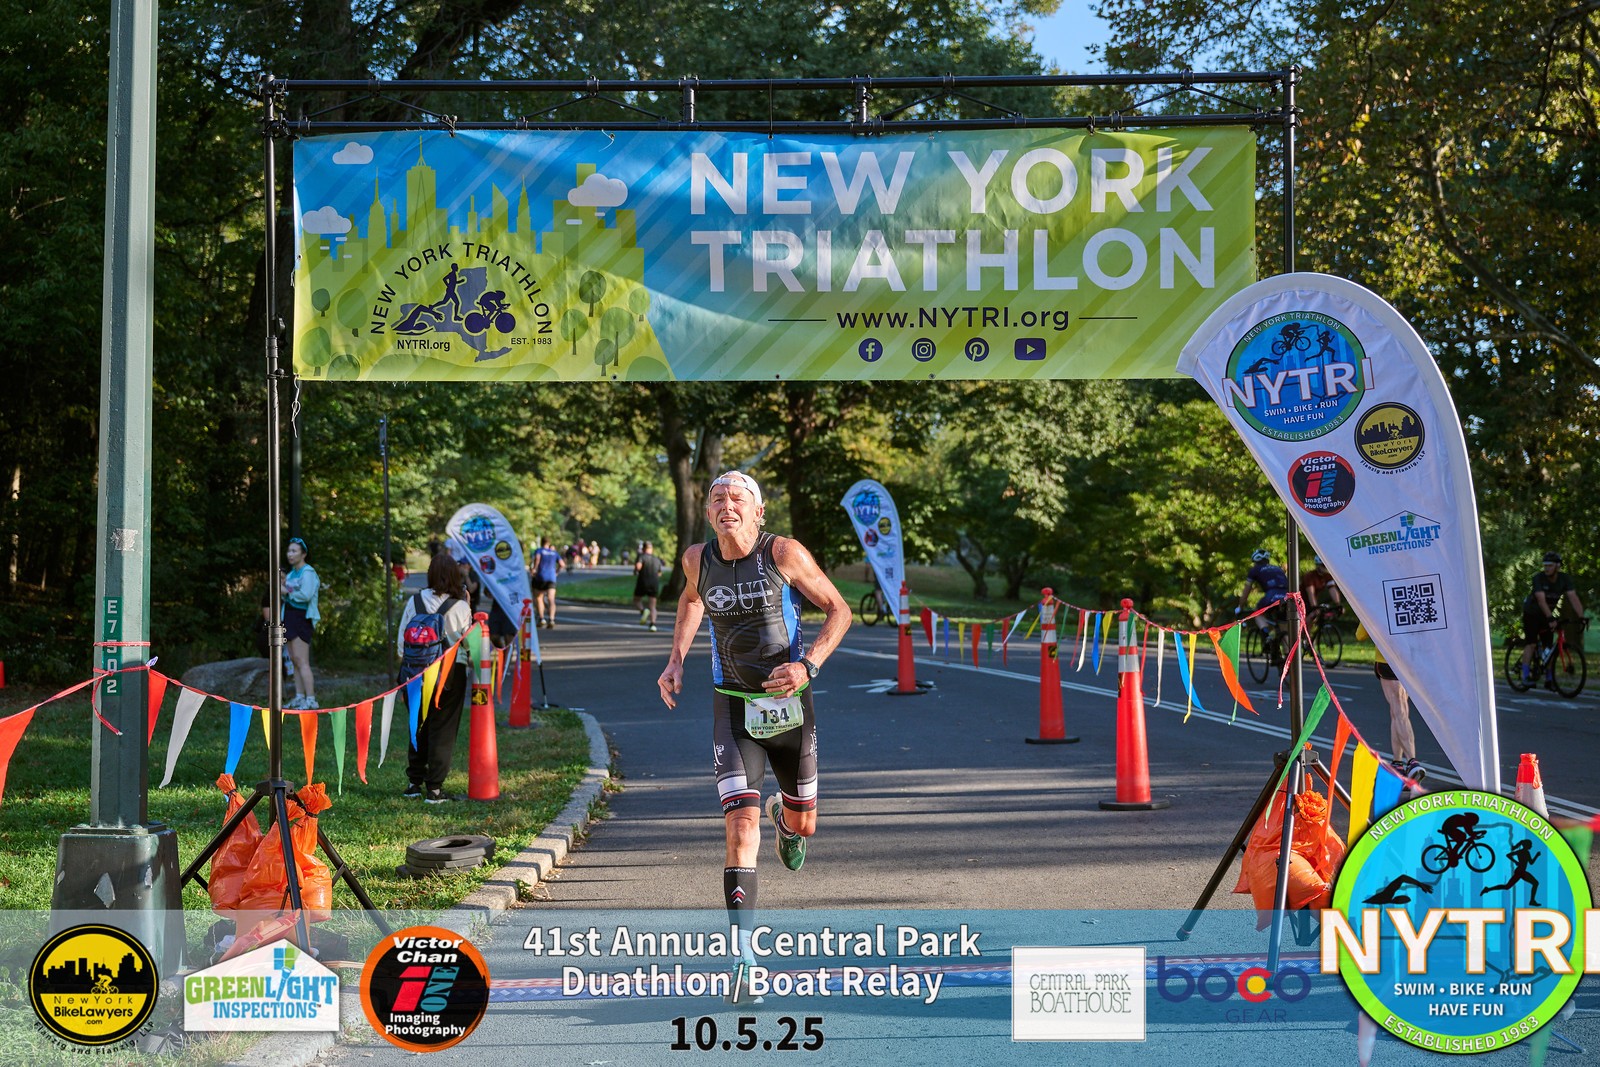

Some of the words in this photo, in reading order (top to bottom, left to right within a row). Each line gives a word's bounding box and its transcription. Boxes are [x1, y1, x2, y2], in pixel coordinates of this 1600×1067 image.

[690, 151, 916, 215] NEW
[948, 147, 1214, 213] YORK
[691, 227, 1216, 292] TRIATHLON
[371, 284, 397, 334] NEW
[394, 243, 453, 280] YORK
[463, 242, 552, 334] TRIATHLON
[836, 307, 1070, 331] www.NYTRI.org
[1243, 326, 1262, 344] NEW
[1263, 314, 1288, 328] YORK
[1289, 312, 1341, 331] TRIATHLON
[397, 340, 451, 352] NYTRI.org
[1222, 357, 1375, 408] NYTRI
[1264, 408, 1287, 417] SWIM
[1294, 404, 1314, 413] BIKE
[1320, 400, 1338, 409] RUN
[1283, 415, 1305, 425] HAVE
[1307, 412, 1325, 421] FUN
[1261, 426, 1322, 440] ESTABLISHED
[1324, 415, 1345, 432] 1983
[1300, 455, 1338, 466] Victor
[1303, 463, 1336, 473] Chan
[1360, 459, 1380, 474] Flanzig
[1417, 450, 1426, 461] LLP
[1304, 500, 1346, 509] Photography
[1350, 523, 1441, 550] GREENLIGHT
[760, 708, 790, 724] 134
